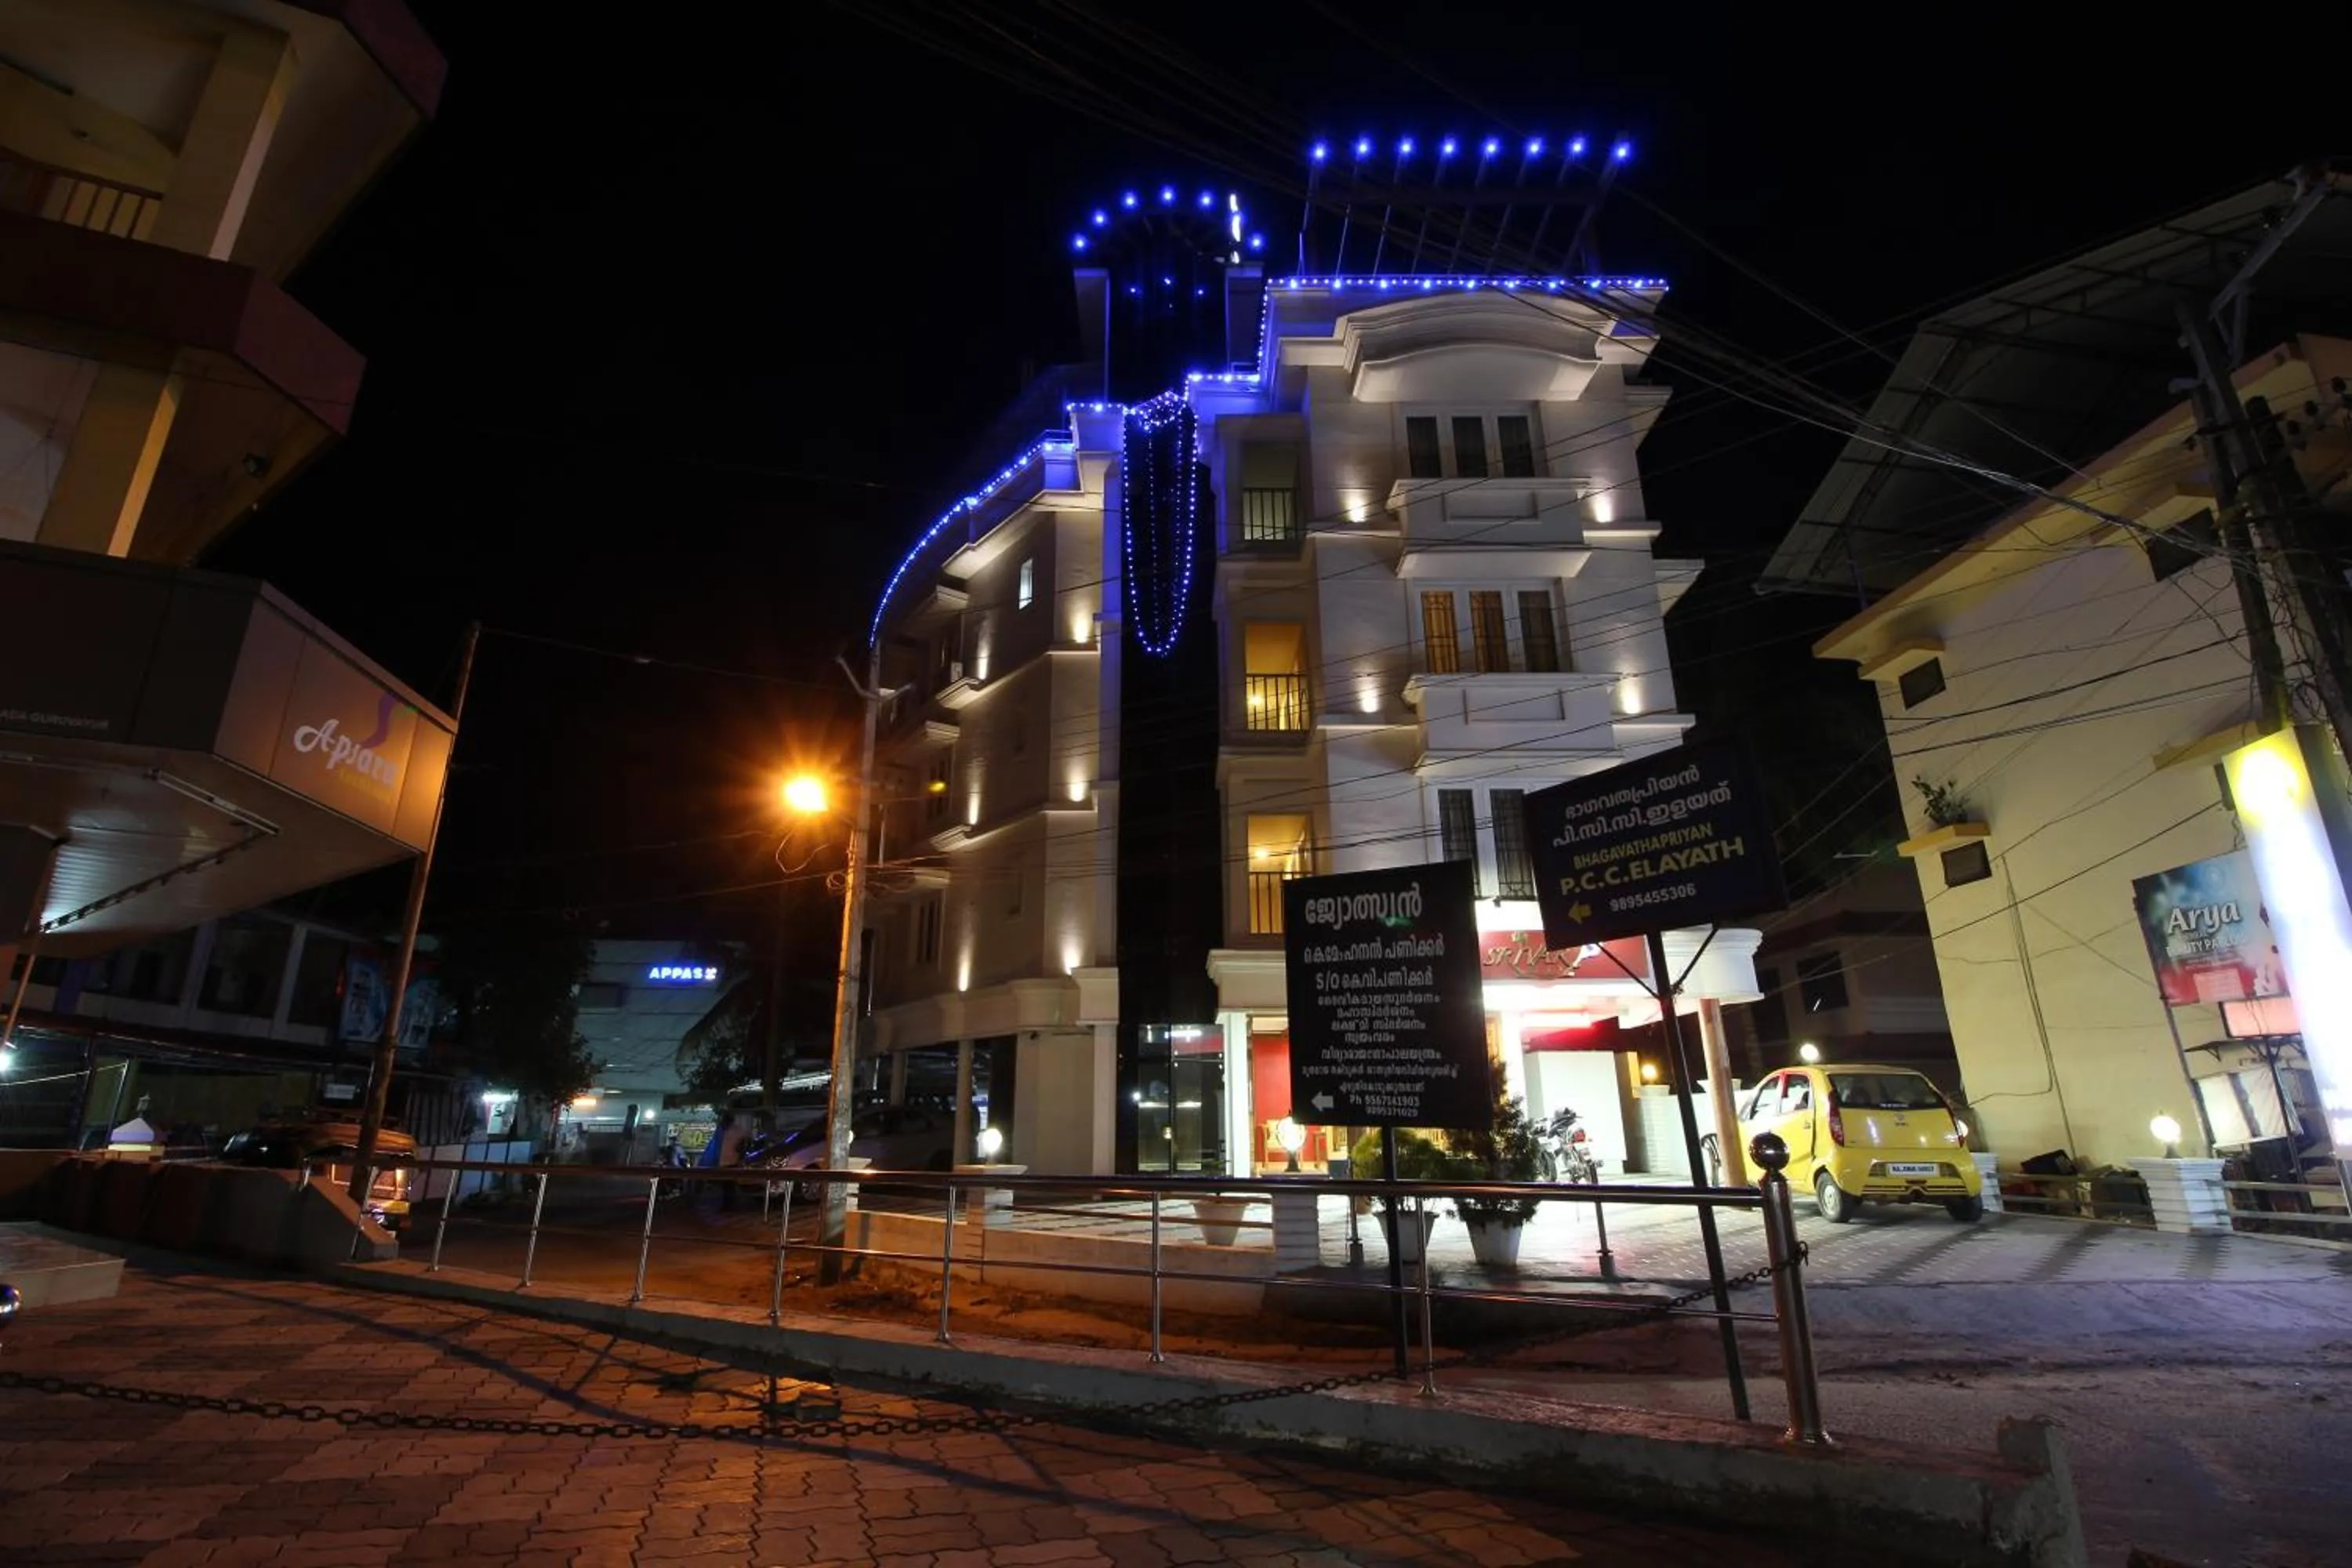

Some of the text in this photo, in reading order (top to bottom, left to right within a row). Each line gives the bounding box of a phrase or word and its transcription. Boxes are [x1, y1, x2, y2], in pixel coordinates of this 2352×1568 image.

[1559, 836, 1745, 896] P.C.C.ELAYATH
[1572, 822, 1715, 871] BHAGAVATHAPRIYAN
[1610, 883, 1697, 913] 9895455306
[2168, 901, 2241, 935] Arya
